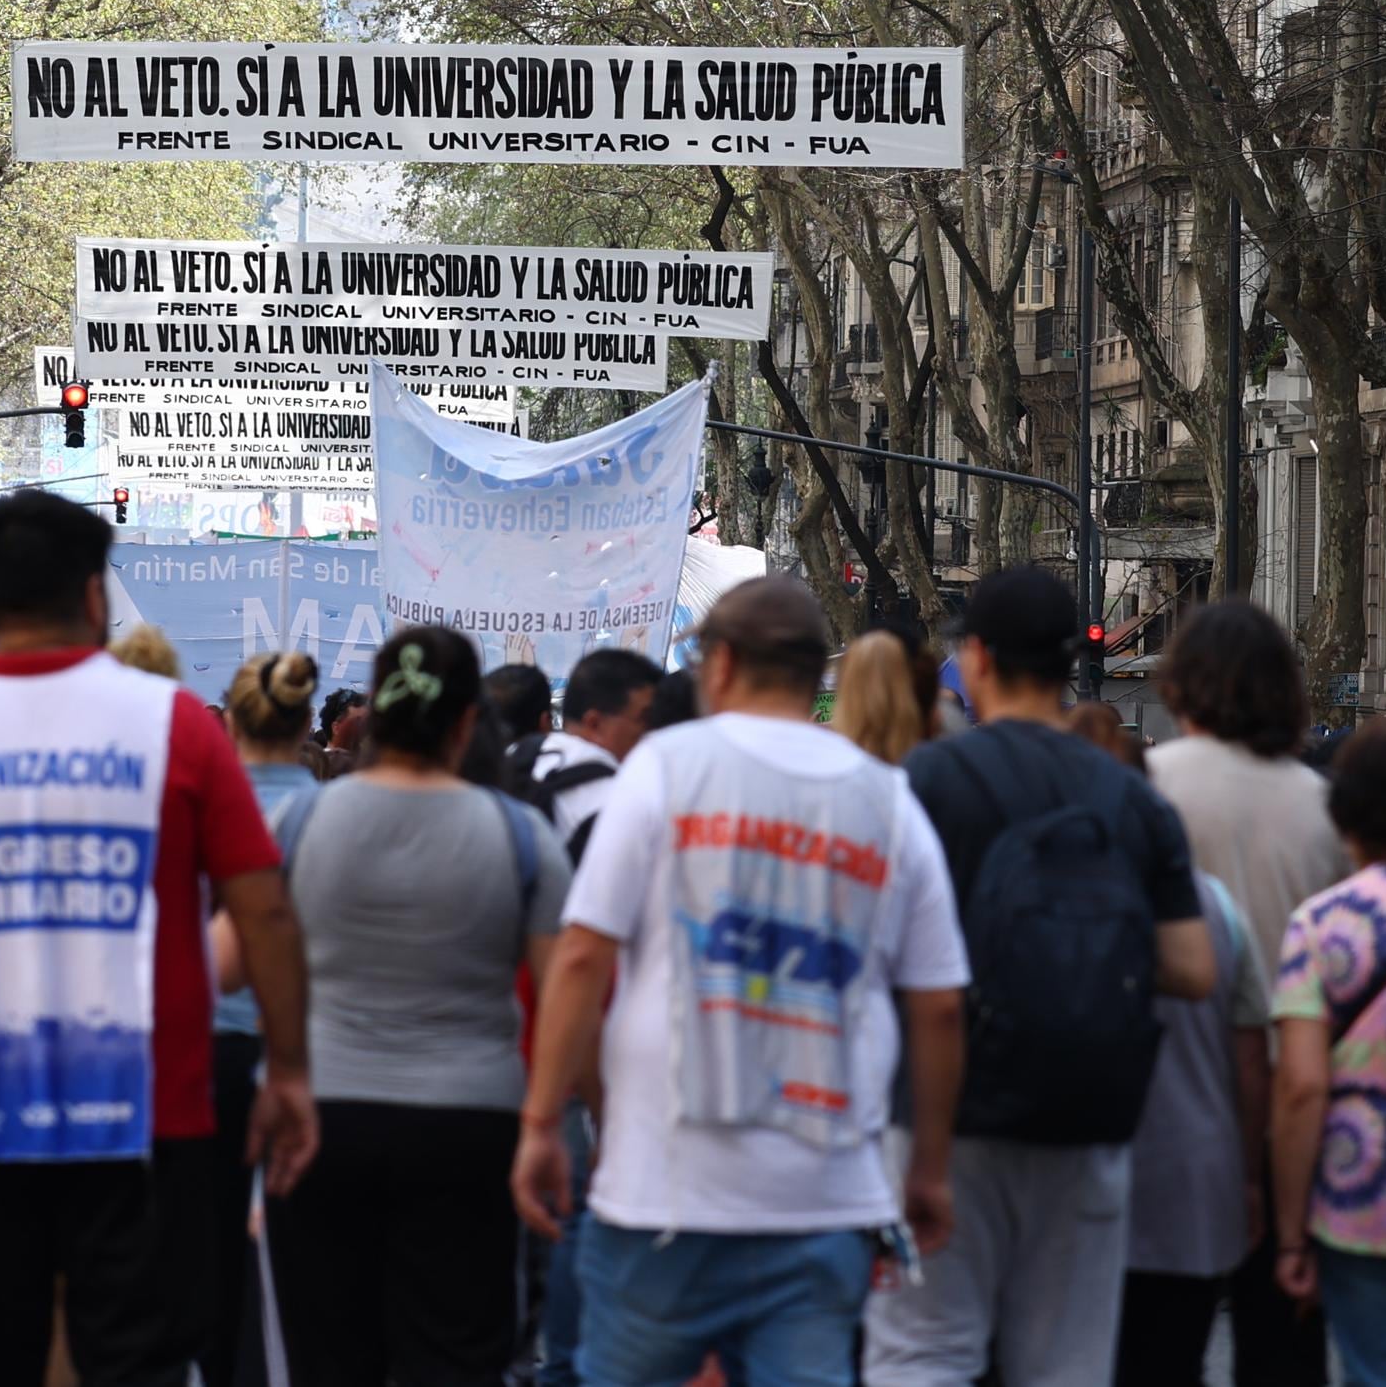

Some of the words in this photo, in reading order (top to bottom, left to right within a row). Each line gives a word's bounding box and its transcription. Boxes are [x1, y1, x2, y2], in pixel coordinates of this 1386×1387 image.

[27, 57, 75, 118] NO
[84, 58, 128, 117] AL
[136, 57, 229, 117] VETO.
[237, 44, 275, 116] SÍ
[278, 56, 305, 117] A
[319, 56, 358, 117] LA
[374, 57, 593, 119] UNIVERSIDAD
[609, 59, 633, 119] Y
[644, 60, 685, 119] LA
[695, 60, 797, 121] SALUD
[811, 52, 945, 125] PÚBLICA
[118, 131, 230, 149] FRENTE
[263, 131, 402, 150] SINDICAL
[429, 132, 669, 152] UNIVERSITARIO
[712, 135, 769, 153] CIN
[810, 137, 870, 154] FUA
[93, 248, 126, 292] NO
[134, 250, 164, 292] AL
[171, 250, 238, 293] VETO.
[243, 244, 269, 293] SÍ
[274, 252, 292, 293] A
[302, 252, 333, 294] LA
[342, 252, 500, 298] UNIVERSIDAD
[511, 256, 529, 299] Y
[537, 258, 567, 300] LA
[574, 259, 648, 303] SALUD
[657, 254, 753, 309] PÚBLICA
[158, 303, 237, 316] FRENTE
[261, 304, 361, 318] SINDICAL
[383, 306, 555, 323] UNIVERSITARIO
[586, 311, 626, 325] CIN
[655, 314, 699, 328] FUA
[88, 322, 117, 352] NO
[124, 323, 150, 352] AL
[157, 324, 213, 352] VETO.
[244, 325, 261, 353] A
[268, 326, 294, 354] LA
[302, 326, 439, 356] UNIVERSIDAD
[449, 329, 461, 357] Y
[471, 329, 497, 358] LA
[502, 331, 565, 359] SALUD
[44, 356, 67, 386] NO
[145, 361, 213, 372] FRENTE
[234, 361, 320, 374] SINDICAL
[338, 363, 486, 377] UNIERSITARIO
[513, 367, 547, 379] CIN
[574, 369, 610, 381] FUA
[90, 393, 145, 403] FRENTE
[163, 394, 232, 404] SINDICAL
[247, 396, 366, 409] UNIVERSITARIO
[439, 404, 468, 415] FUA
[130, 412, 150, 437] NO
[155, 412, 172, 437] AL
[177, 412, 215, 437] VETO.
[238, 413, 247, 437] A
[254, 412, 271, 438] LA
[277, 413, 370, 439] UNIVERSIDAD
[231, 444, 289, 452] SINDICAL
[301, 444, 373, 453] UNIVERSIT
[201, 473, 251, 483] SINDICAL
[261, 475, 347, 483] UNIVERSITARIO
